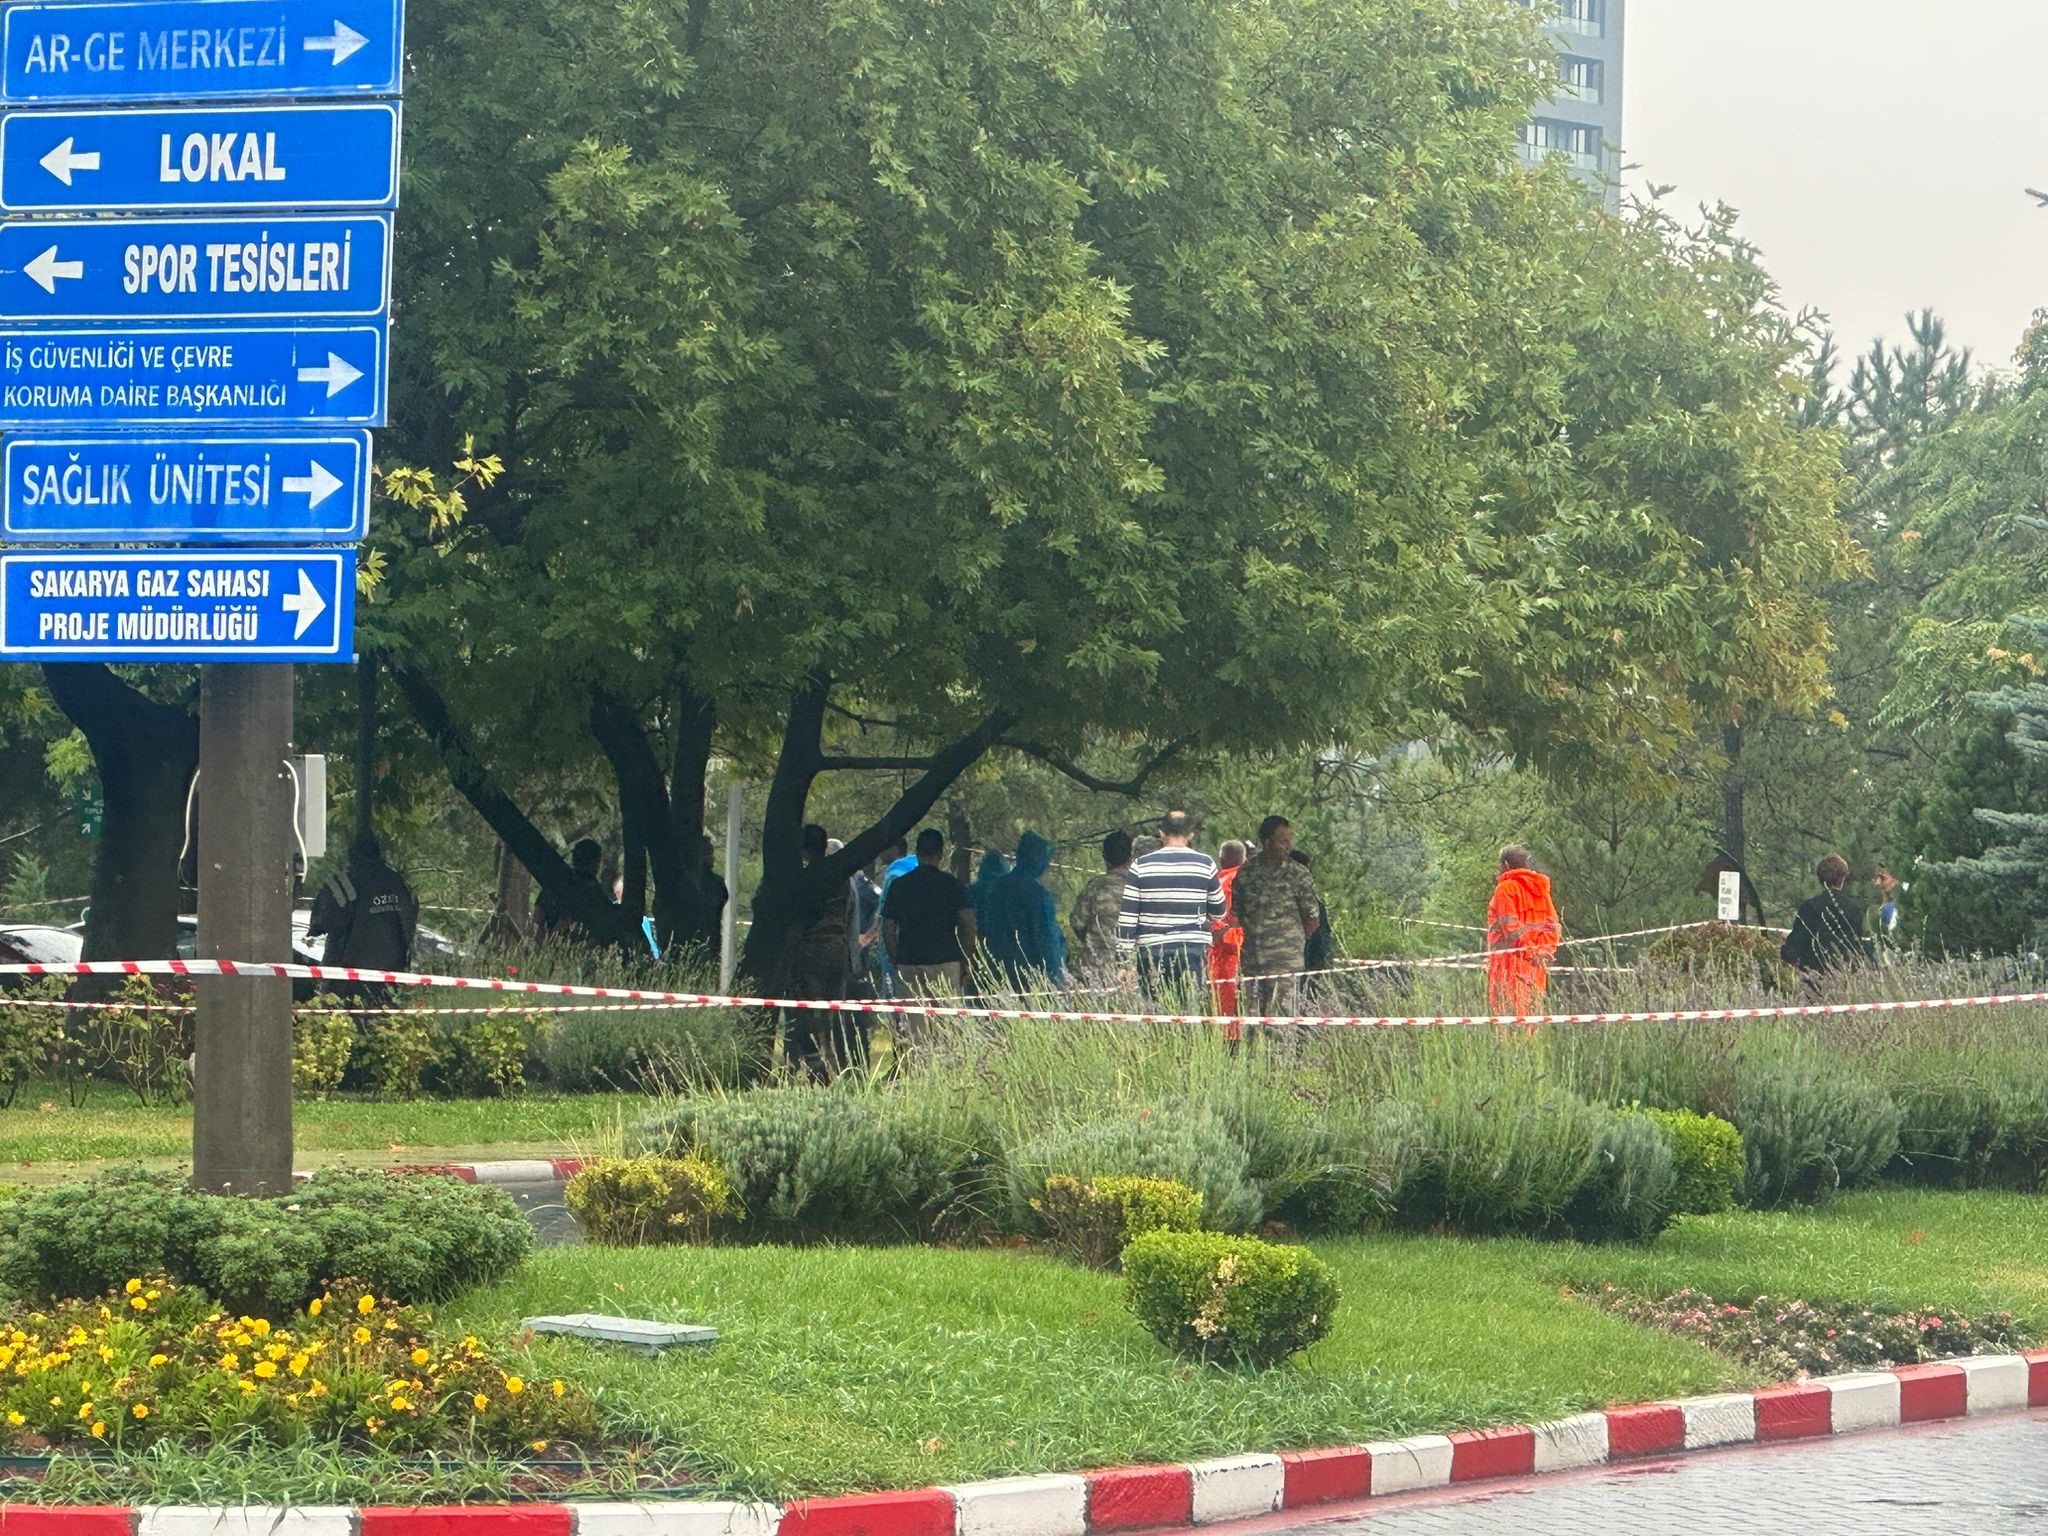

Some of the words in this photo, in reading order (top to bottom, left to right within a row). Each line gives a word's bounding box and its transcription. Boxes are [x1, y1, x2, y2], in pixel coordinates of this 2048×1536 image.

[25, 32, 125, 73] AR-GE
[138, 14, 287, 71] MERKEZİ
[159, 132, 286, 182] LOKAL
[123, 243, 198, 294] SPOR
[206, 229, 352, 292] TESİSLERİ
[5, 341, 23, 375] İŞ
[30, 340, 134, 369] GÜVENLİĞİ
[141, 346, 165, 368] VE
[172, 346, 233, 373] ÇEVRE
[4, 385, 93, 408] KORUMA
[101, 379, 160, 407] DAİRE
[167, 379, 287, 412] BAŞKANLIĞI
[22, 452, 132, 506] SAĞLIK
[149, 452, 271, 507] ÜNİTESİ
[30, 569, 129, 598] SAKARYA
[137, 569, 179, 598] GAZ
[187, 569, 270, 597] SAHASI
[39, 612, 109, 641] PROJE
[117, 605, 258, 641] MÜDÜRLÜĞÜ
